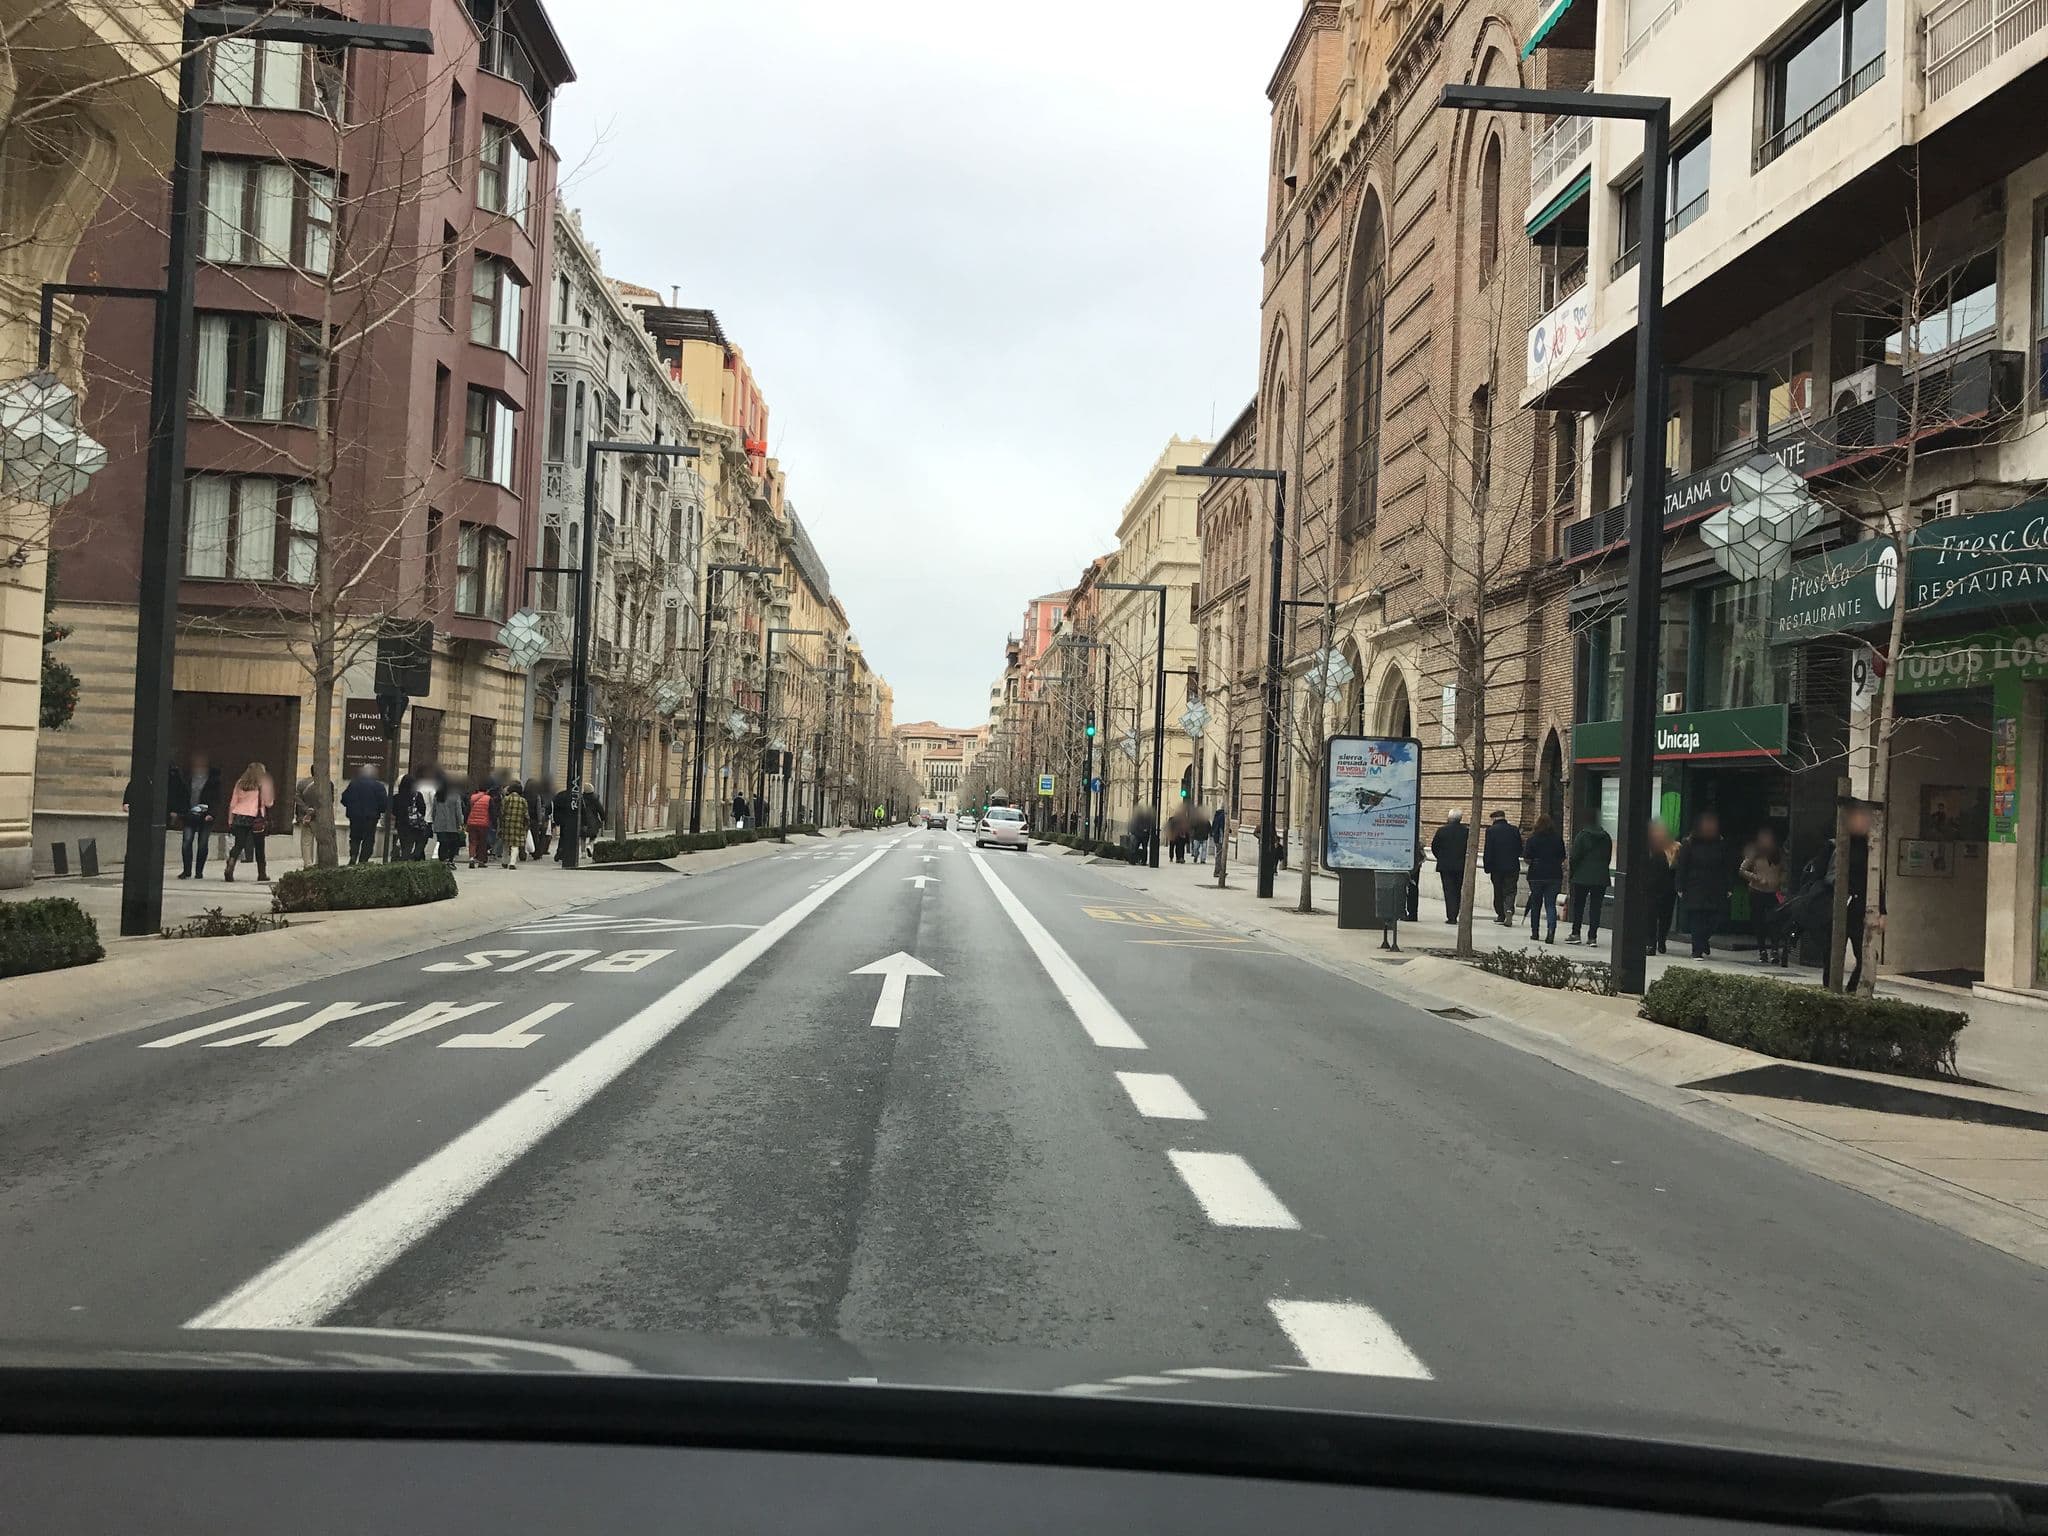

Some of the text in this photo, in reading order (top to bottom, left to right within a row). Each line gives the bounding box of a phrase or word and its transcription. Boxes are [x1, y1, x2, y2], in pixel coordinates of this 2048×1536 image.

[1779, 598, 1861, 632] RESTAURANTE
[1853, 659, 1867, 696] 9
[359, 723, 376, 731] five
[1657, 723, 1700, 753] Unicaja
[420, 949, 677, 972] BUS
[137, 1001, 575, 1049] TAXI
